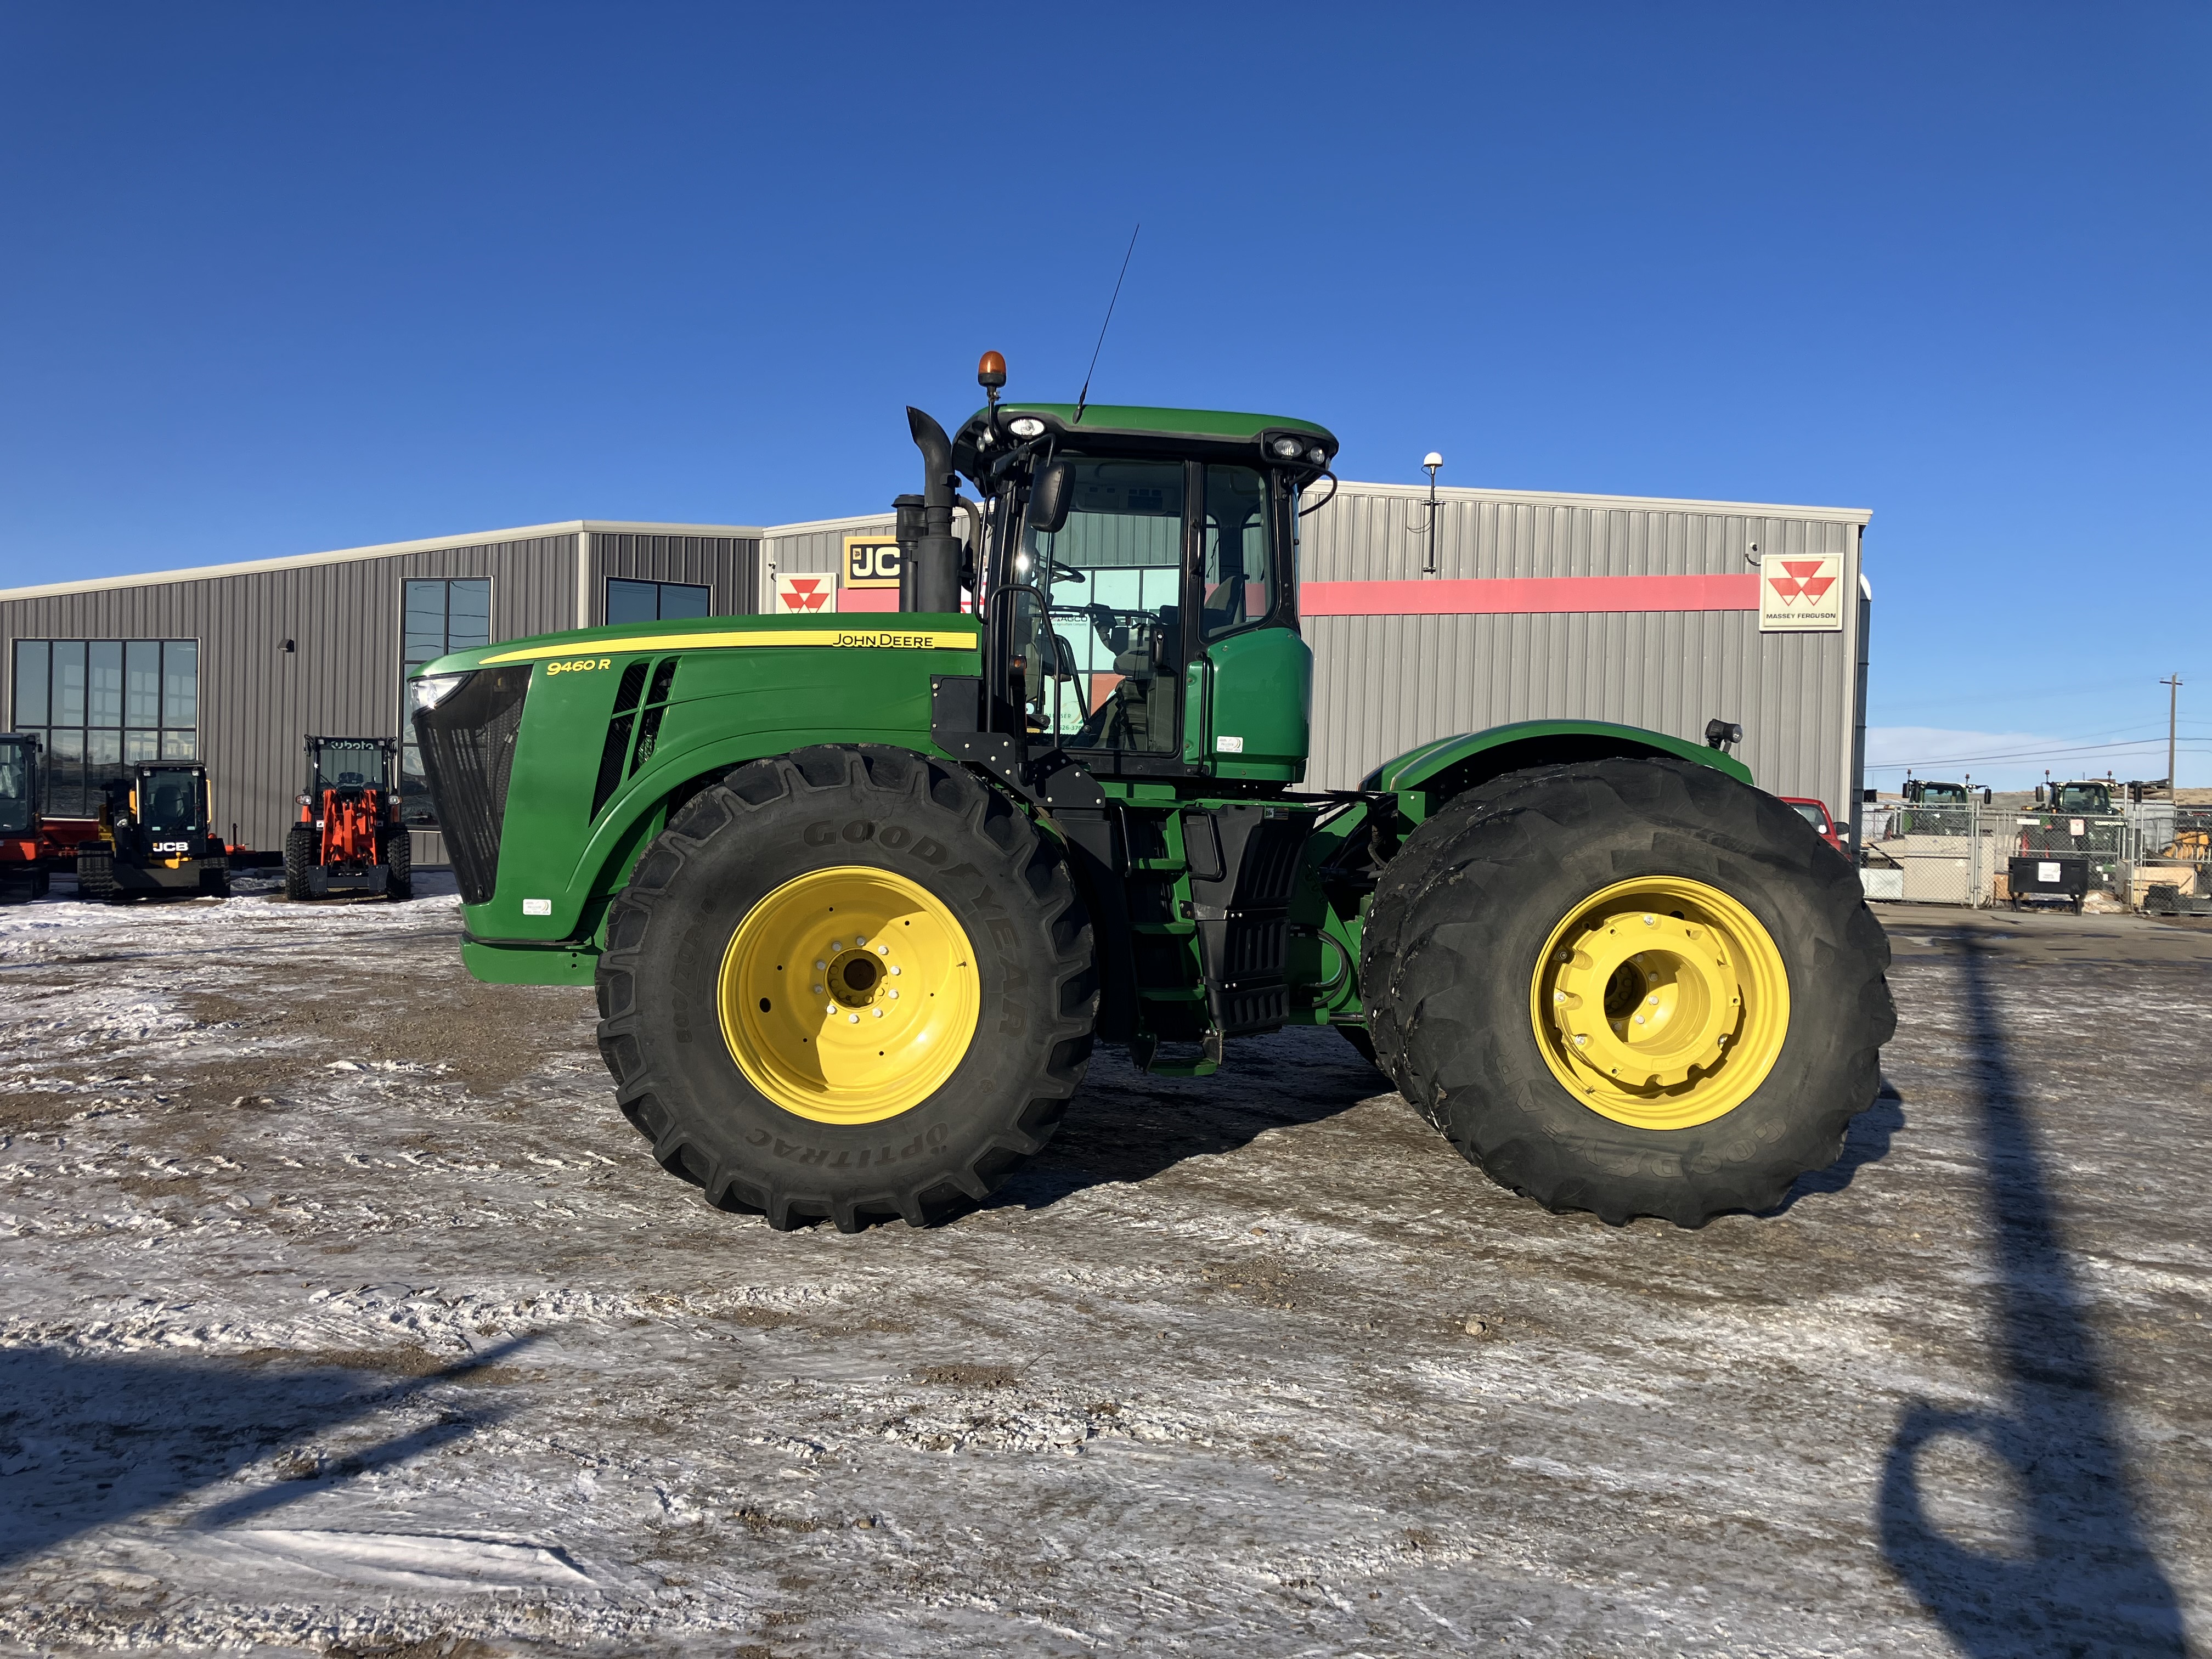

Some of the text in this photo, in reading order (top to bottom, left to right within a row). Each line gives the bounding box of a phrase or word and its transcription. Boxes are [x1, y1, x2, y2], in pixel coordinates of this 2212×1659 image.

[853, 547, 900, 577] JC
[833, 633, 933, 646] JOHN DEERE
[546, 659, 611, 676] 9460 R
[331, 741, 374, 750] Kubota
[153, 842, 188, 852] JCB
[803, 818, 1029, 1041] GOODYEAR
